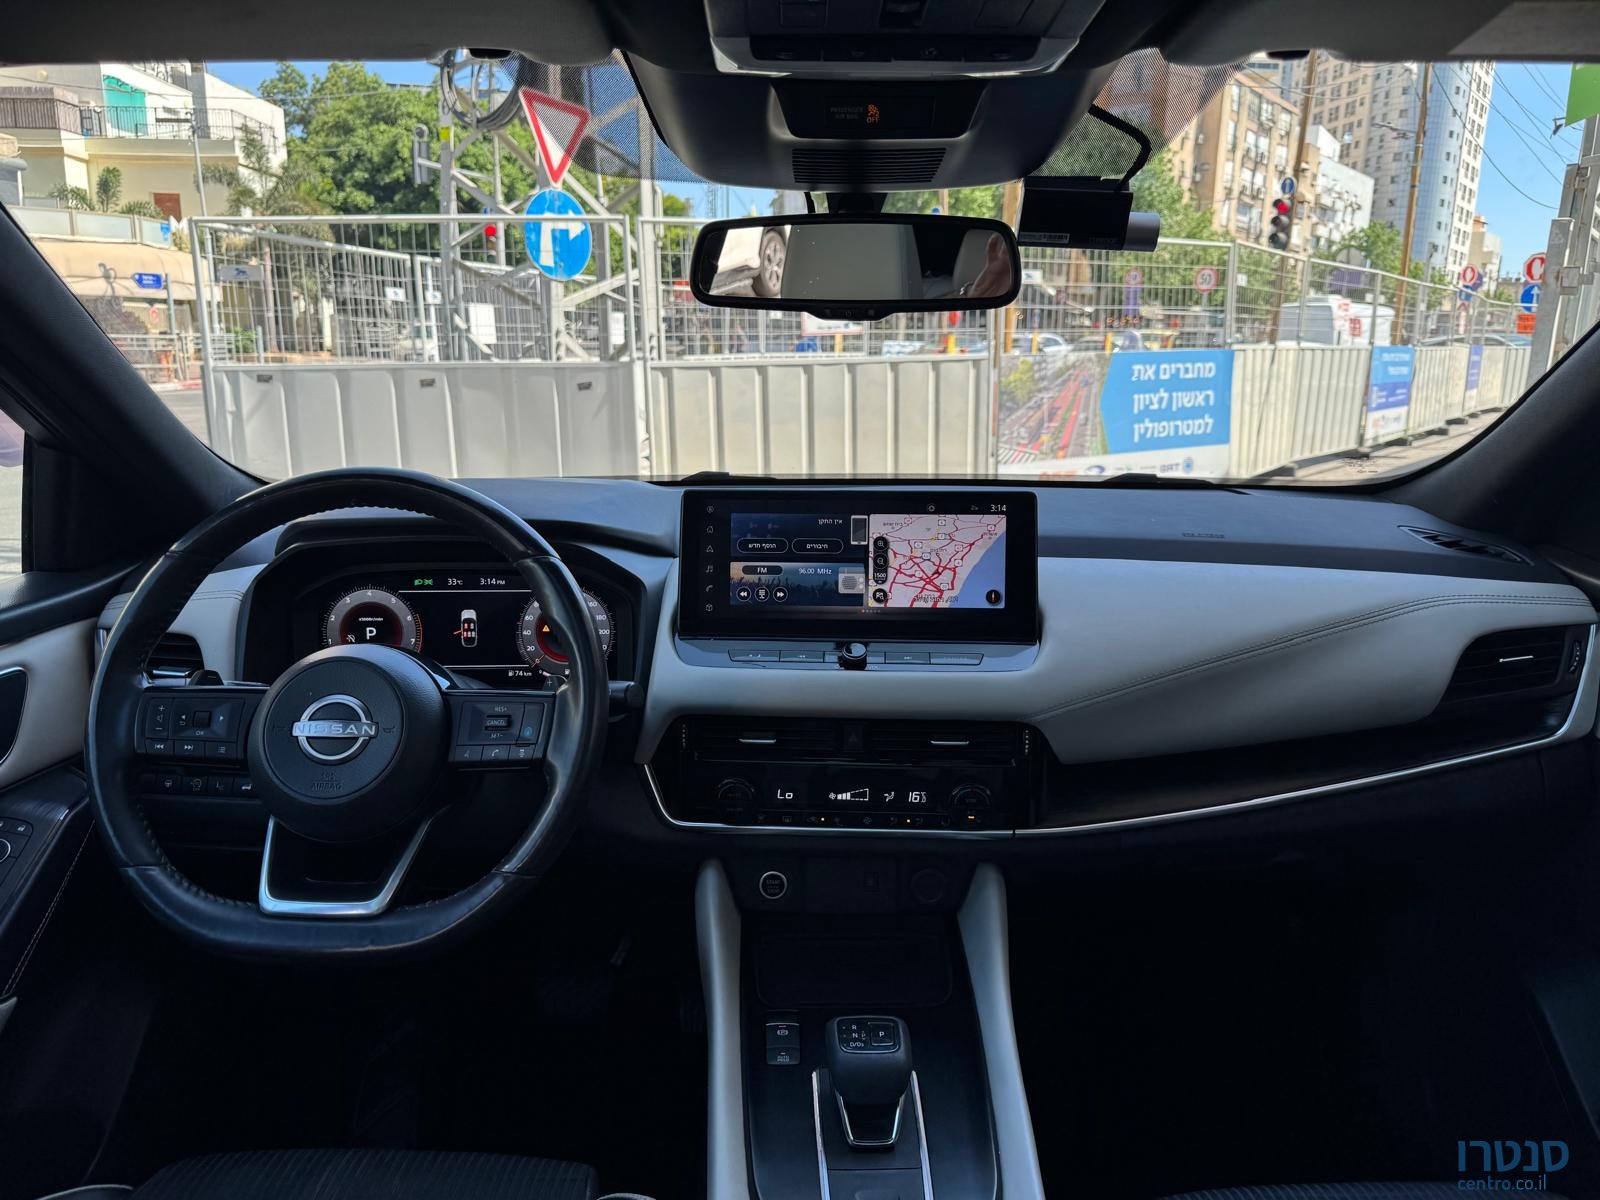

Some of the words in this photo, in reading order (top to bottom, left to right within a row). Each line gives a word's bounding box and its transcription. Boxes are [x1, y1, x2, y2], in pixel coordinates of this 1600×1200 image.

[1132, 363, 1156, 381] את
[1159, 362, 1216, 380] מחברים
[1133, 388, 1168, 414] לציון
[1172, 390, 1214, 412] ראשון
[1133, 413, 1214, 443] למטרופולין
[990, 504, 1007, 512] 3:14
[366, 627, 377, 640] P
[295, 723, 376, 736] NISSAN
[777, 788, 794, 799] Lo
